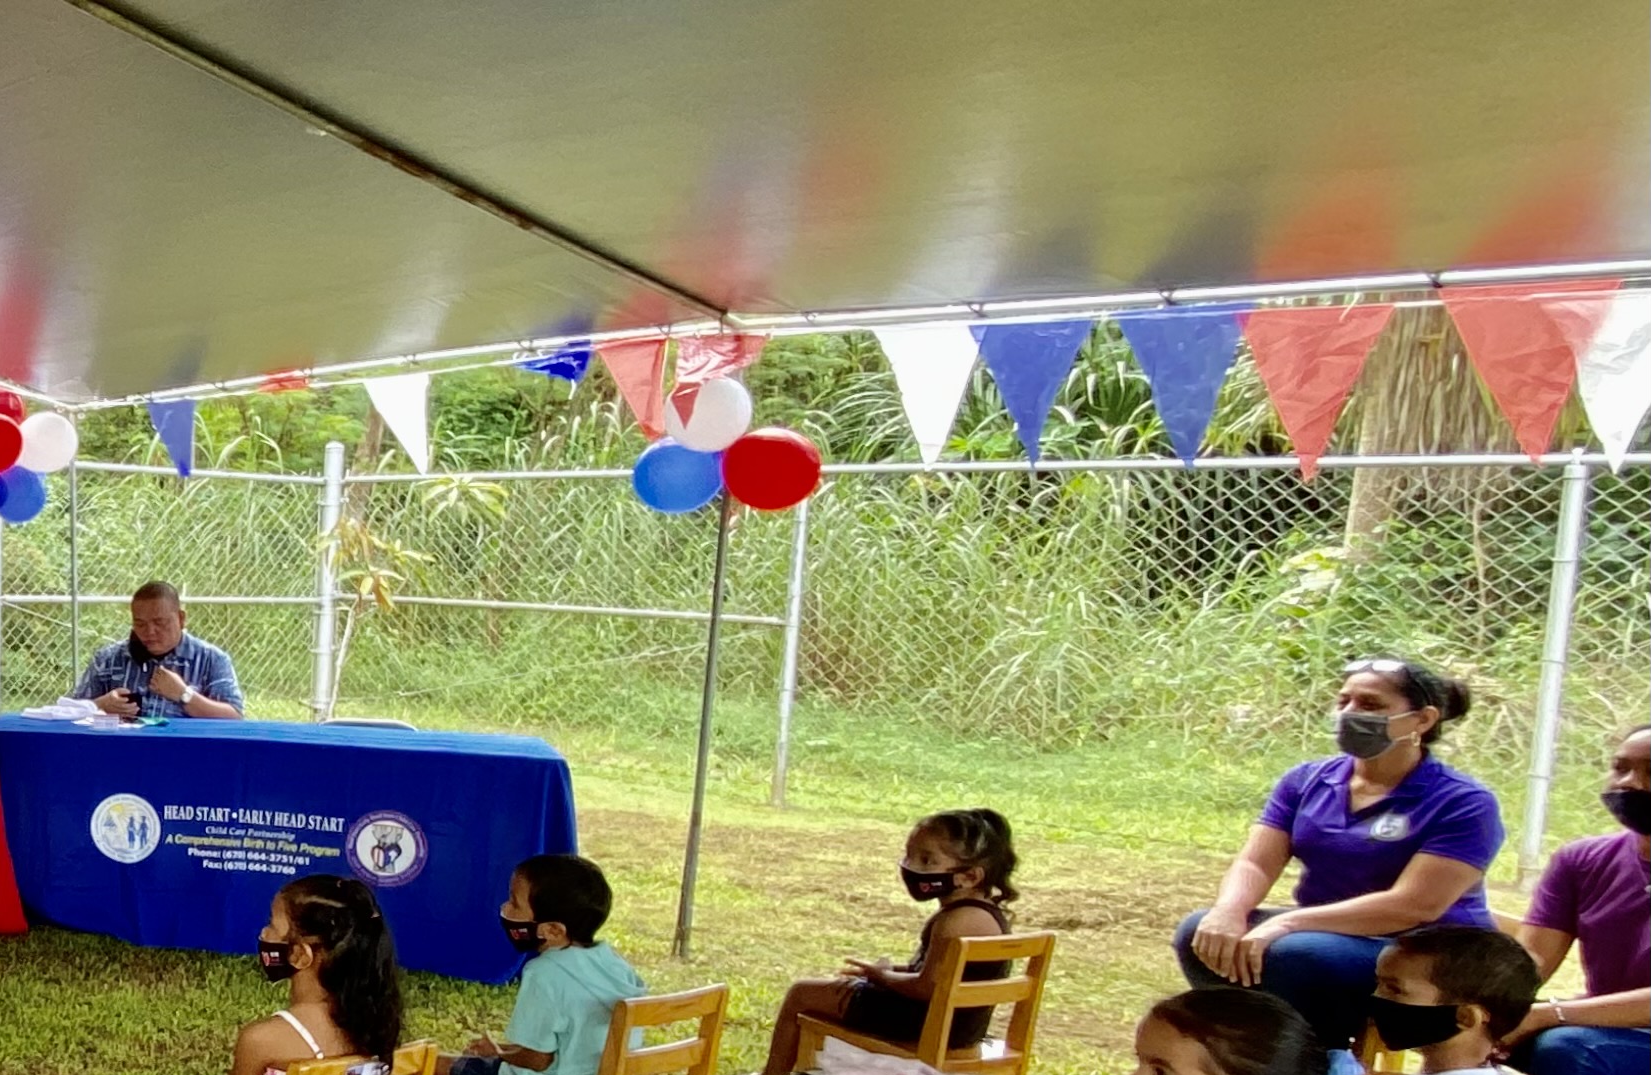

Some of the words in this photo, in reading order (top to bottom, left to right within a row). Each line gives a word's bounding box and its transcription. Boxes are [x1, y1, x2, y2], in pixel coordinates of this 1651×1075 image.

[164, 805, 194, 821] HEAD
[195, 806, 231, 823] START
[238, 808, 273, 826] EARLY
[274, 811, 306, 828] HEAD
[307, 814, 345, 833] START
[205, 826, 227, 836] Child
[165, 834, 173, 844] A
[243, 838, 265, 850] Birth
[266, 839, 276, 850] to
[277, 840, 297, 852] Five
[299, 843, 341, 857] Program
[187, 847, 221, 859] Phone:
[203, 860, 222, 869] Fax:
